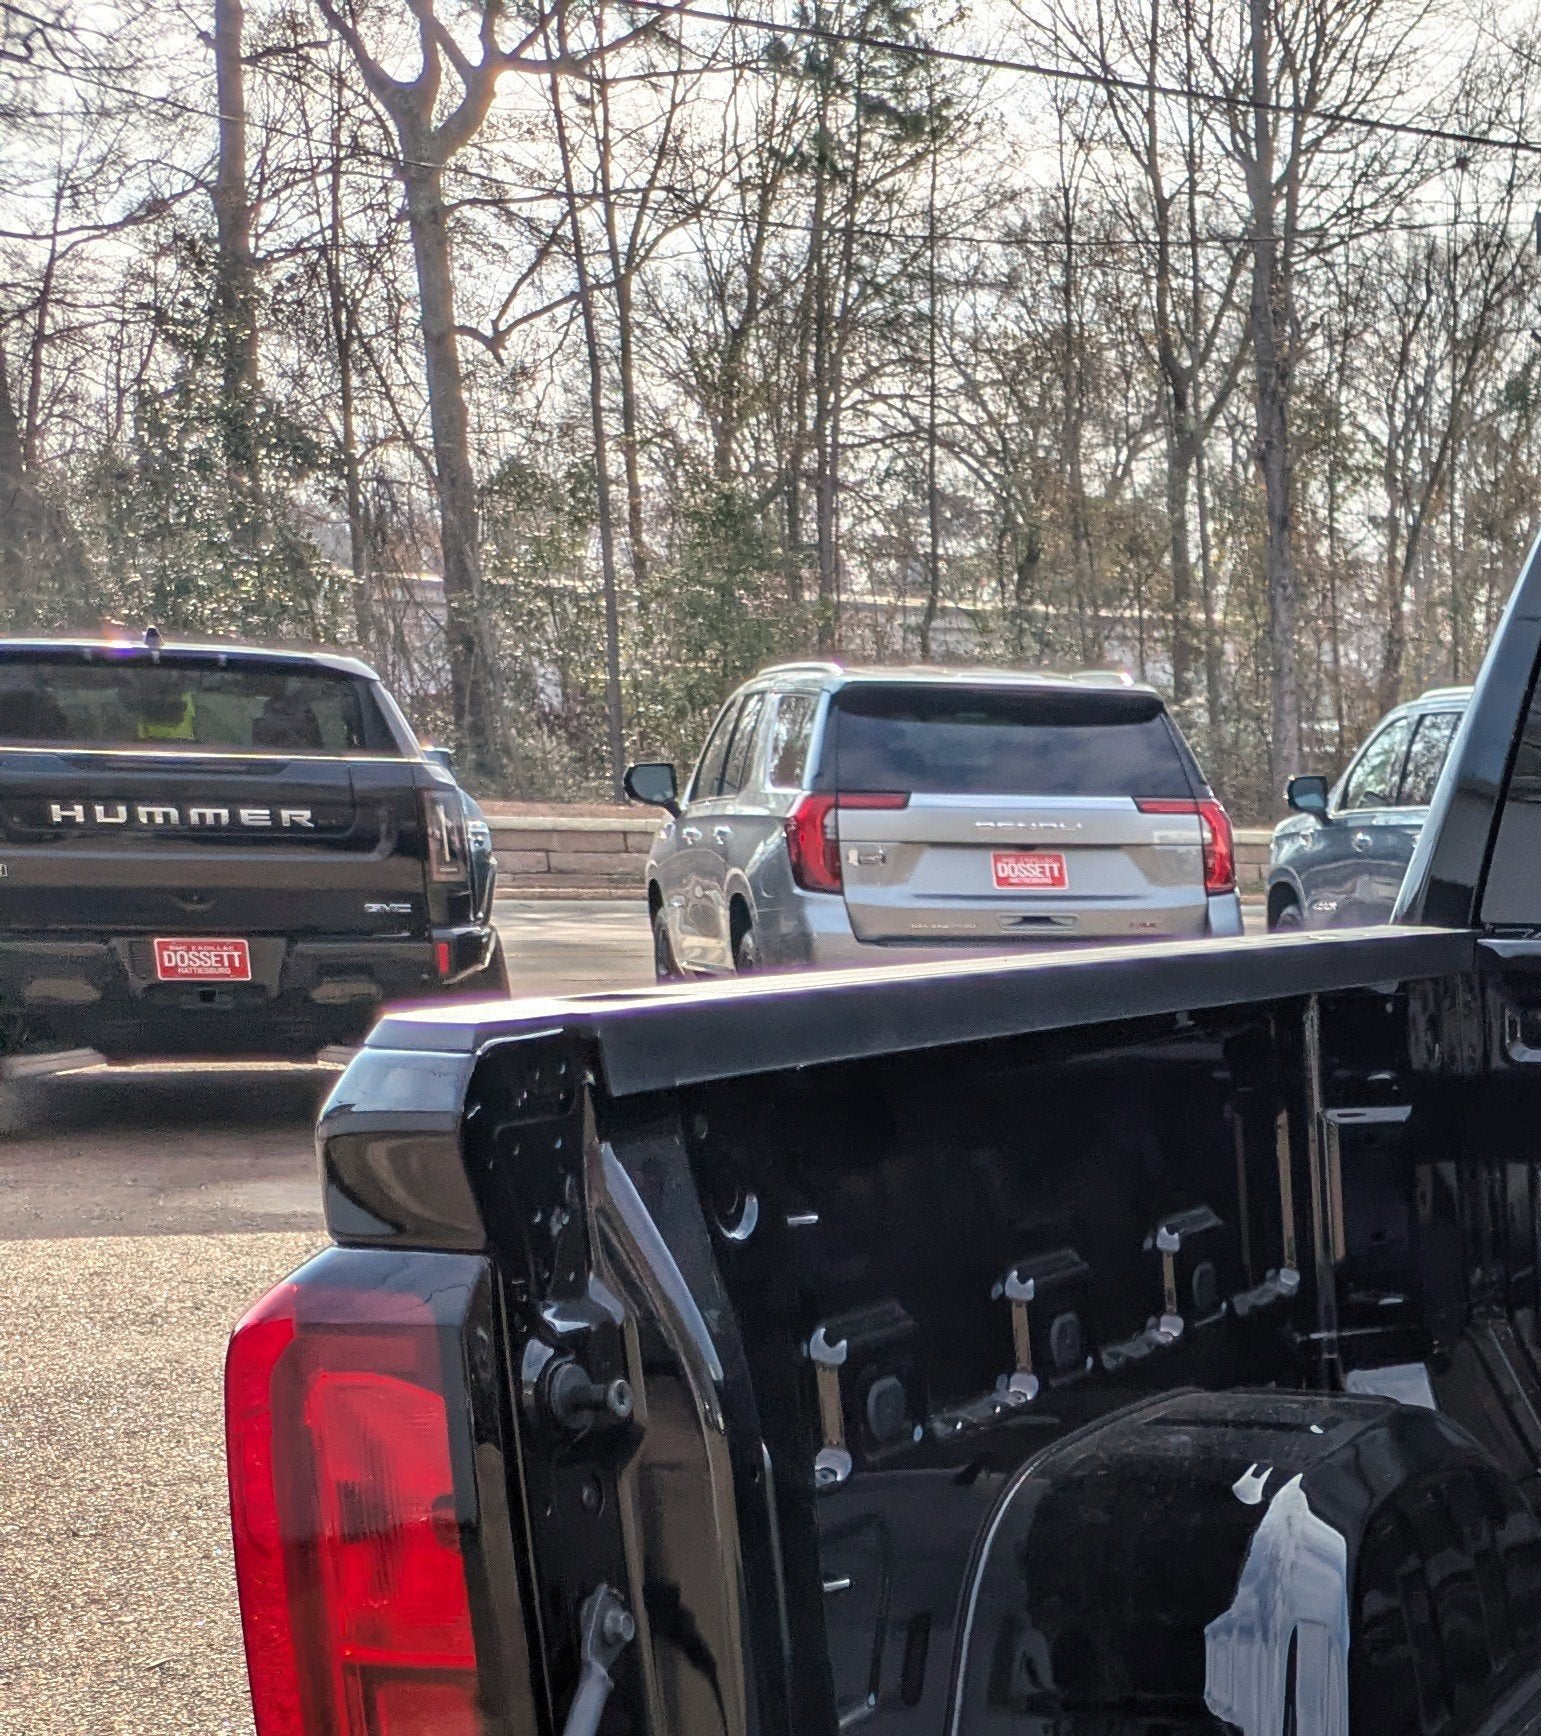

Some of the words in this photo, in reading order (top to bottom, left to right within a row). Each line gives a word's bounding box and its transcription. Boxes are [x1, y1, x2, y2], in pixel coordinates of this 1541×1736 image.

[50, 804, 315, 828] HUMMER
[997, 862, 1061, 878] DOSSETT
[364, 903, 412, 913] GMC
[162, 950, 242, 968] DOSSETT
